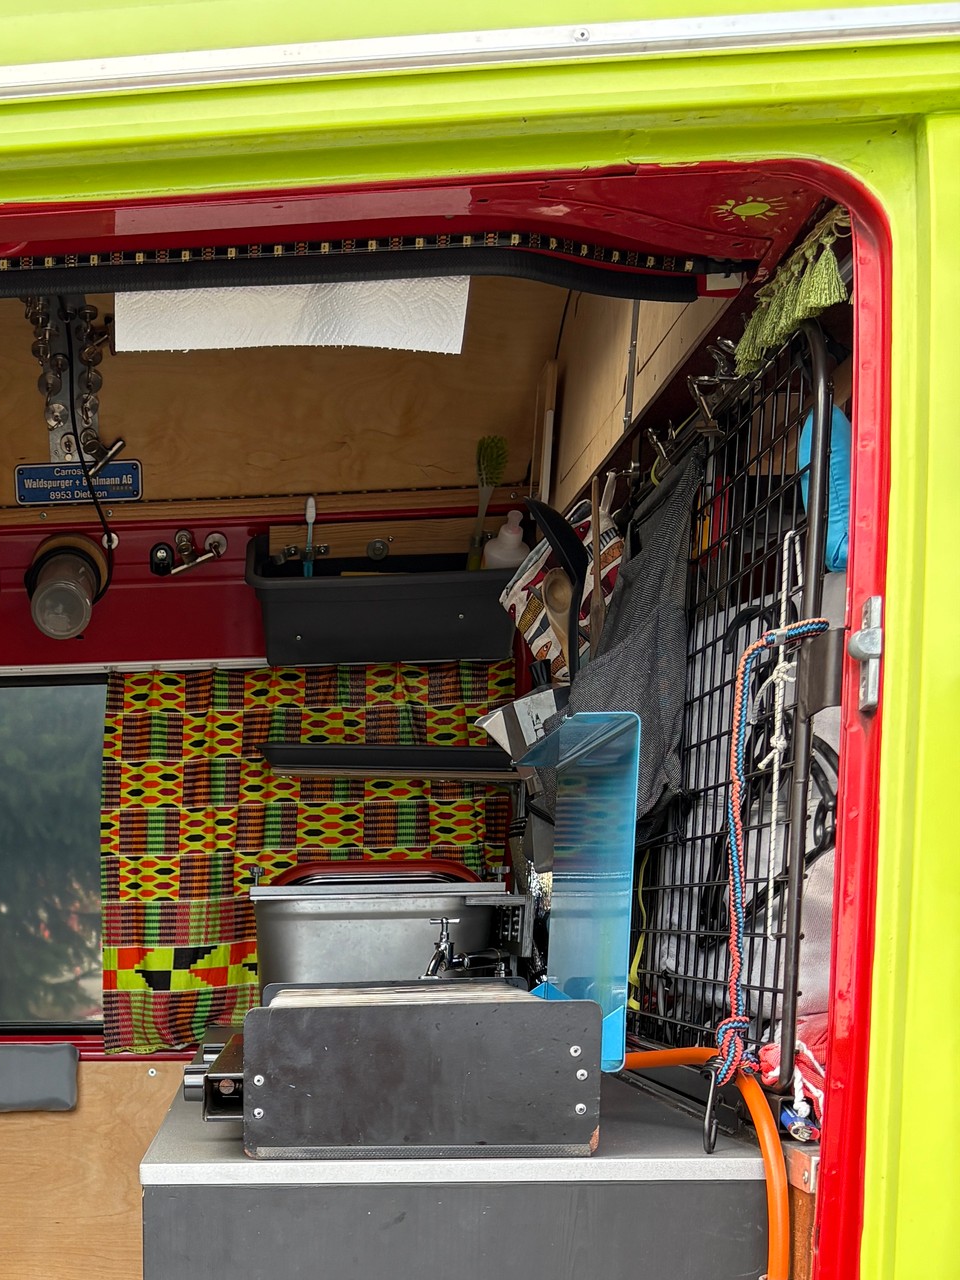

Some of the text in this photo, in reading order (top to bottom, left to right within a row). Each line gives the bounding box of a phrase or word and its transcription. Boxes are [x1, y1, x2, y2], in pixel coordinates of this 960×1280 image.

[24, 478, 73, 489] Waldspurger
[82, 475, 120, 486] Bhlmann
[122, 474, 133, 485] AG
[49, 490, 108, 500] 8953 Dieton
